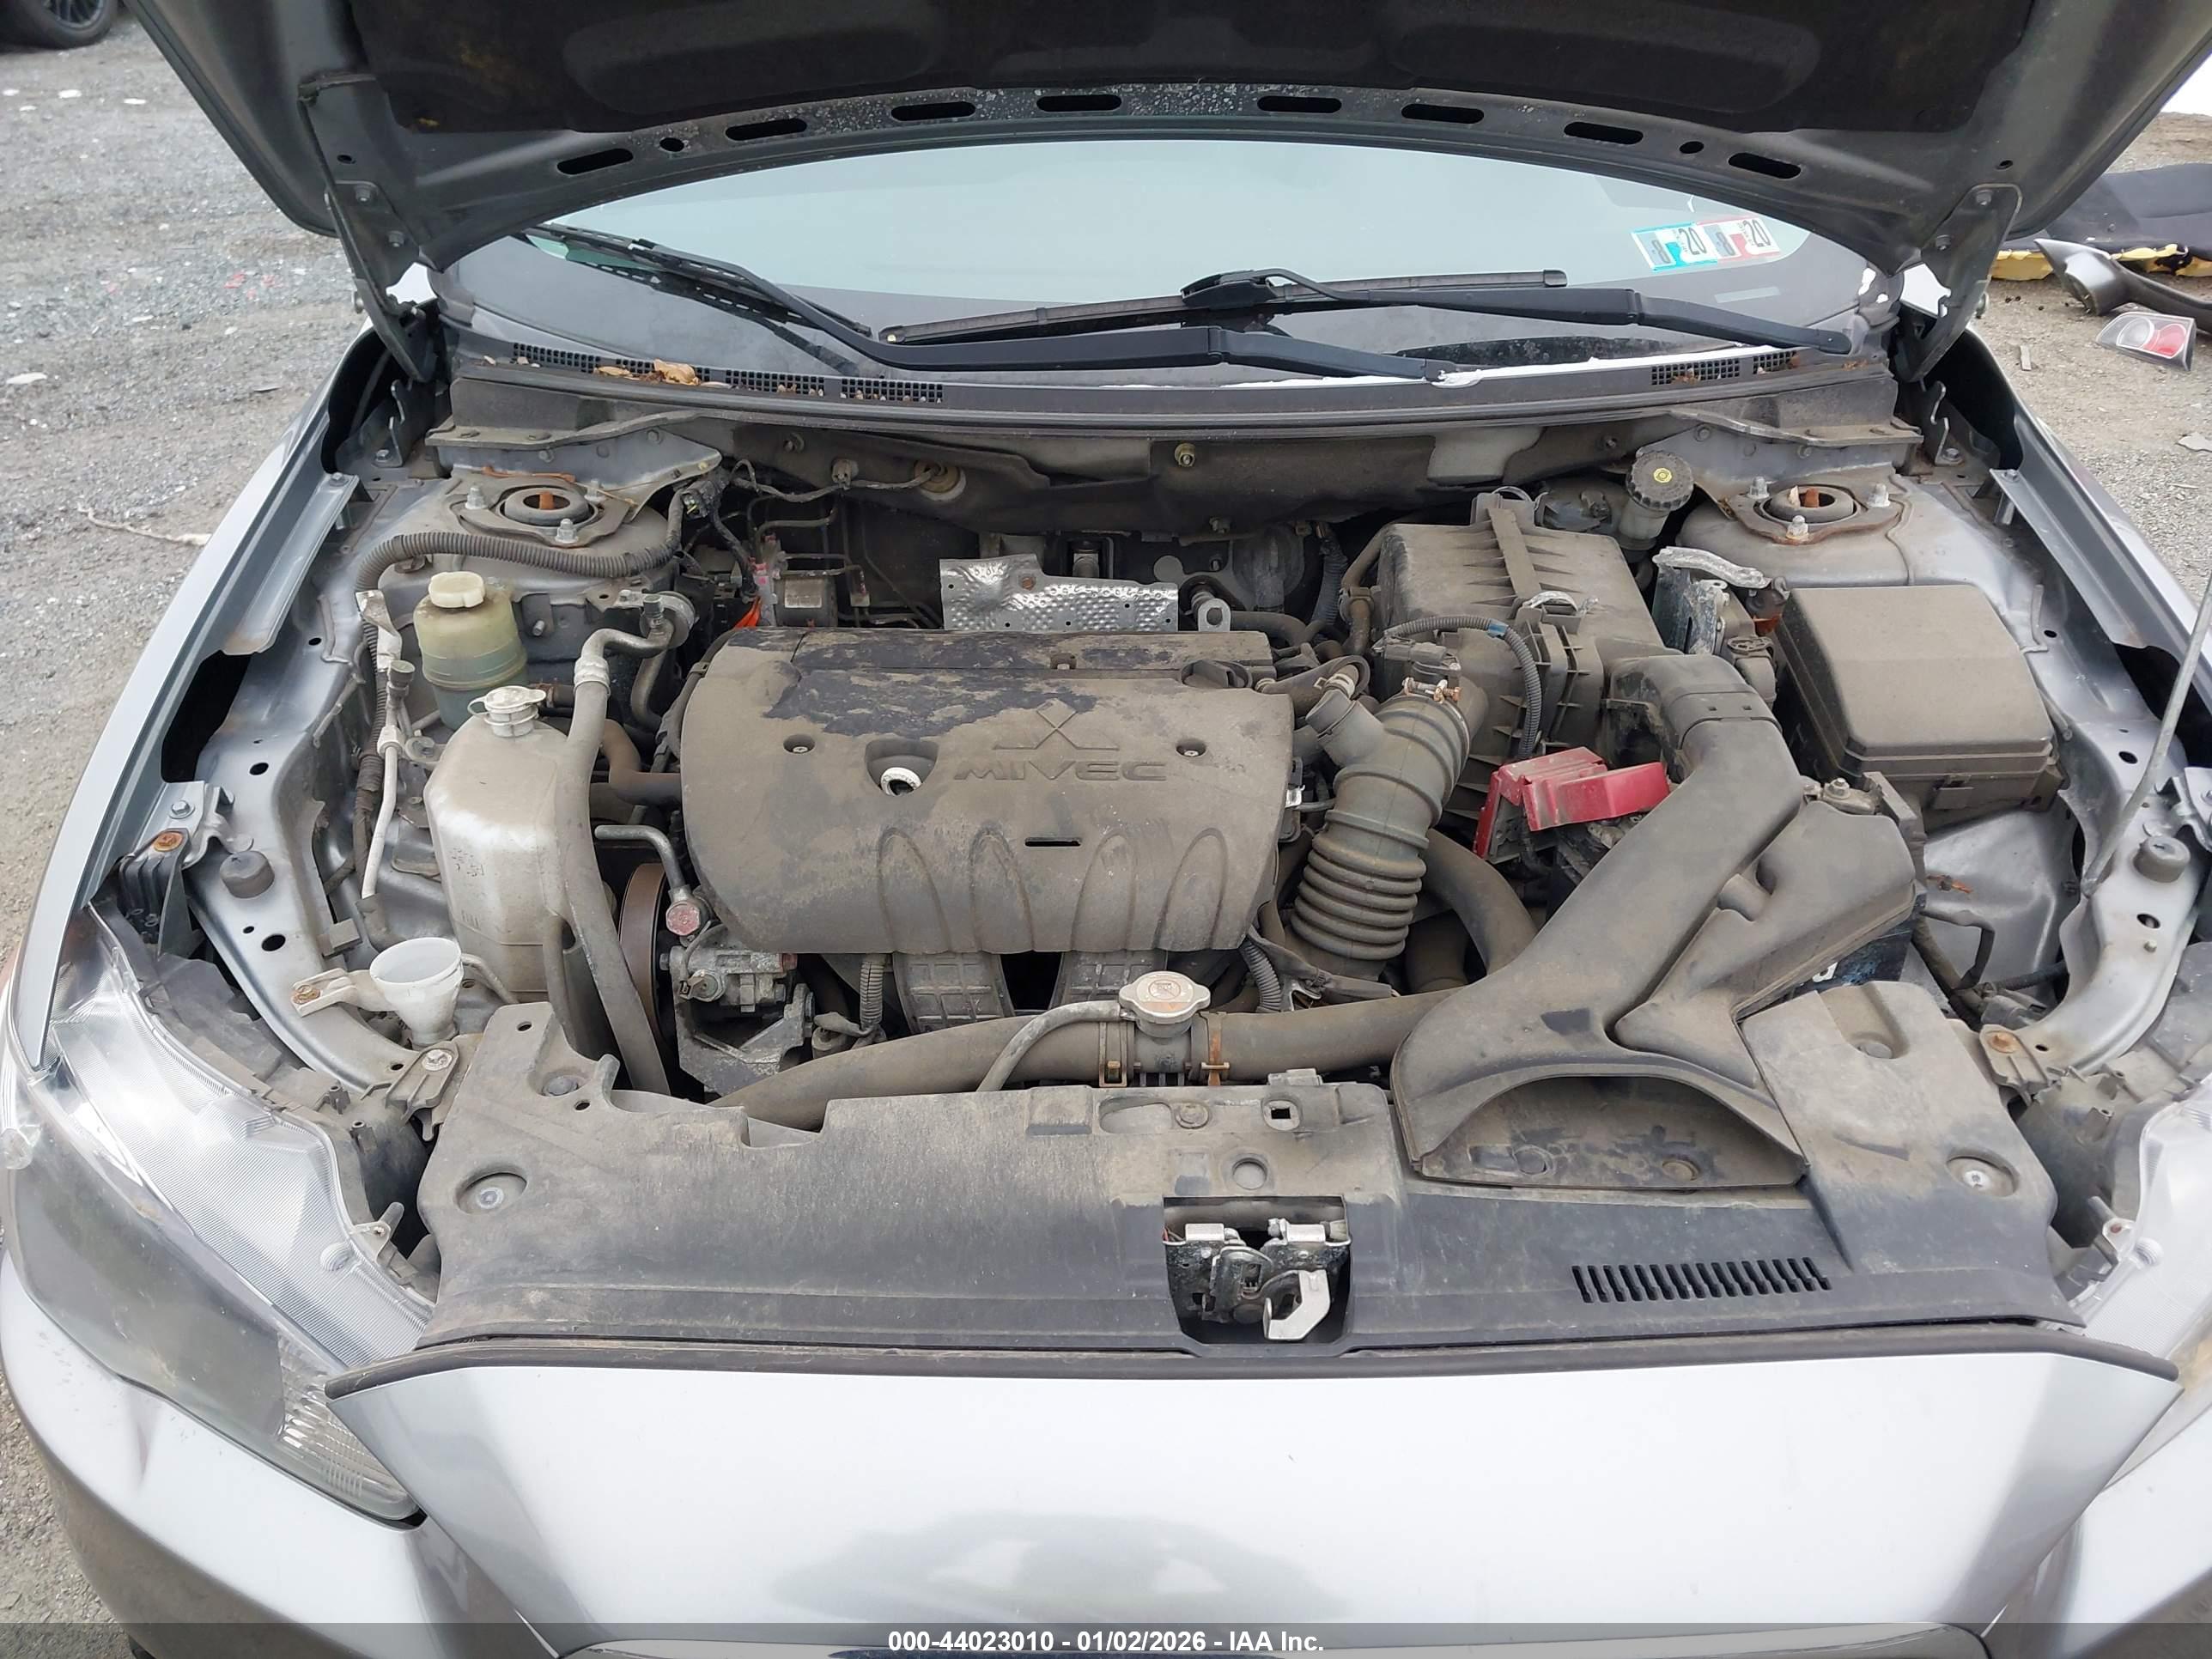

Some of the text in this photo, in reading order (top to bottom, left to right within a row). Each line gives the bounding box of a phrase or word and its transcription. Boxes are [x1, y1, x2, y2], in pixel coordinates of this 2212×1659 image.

[1679, 227, 1706, 256] 20
[1743, 219, 1771, 247] 20
[953, 761, 1167, 781] MIVEC
